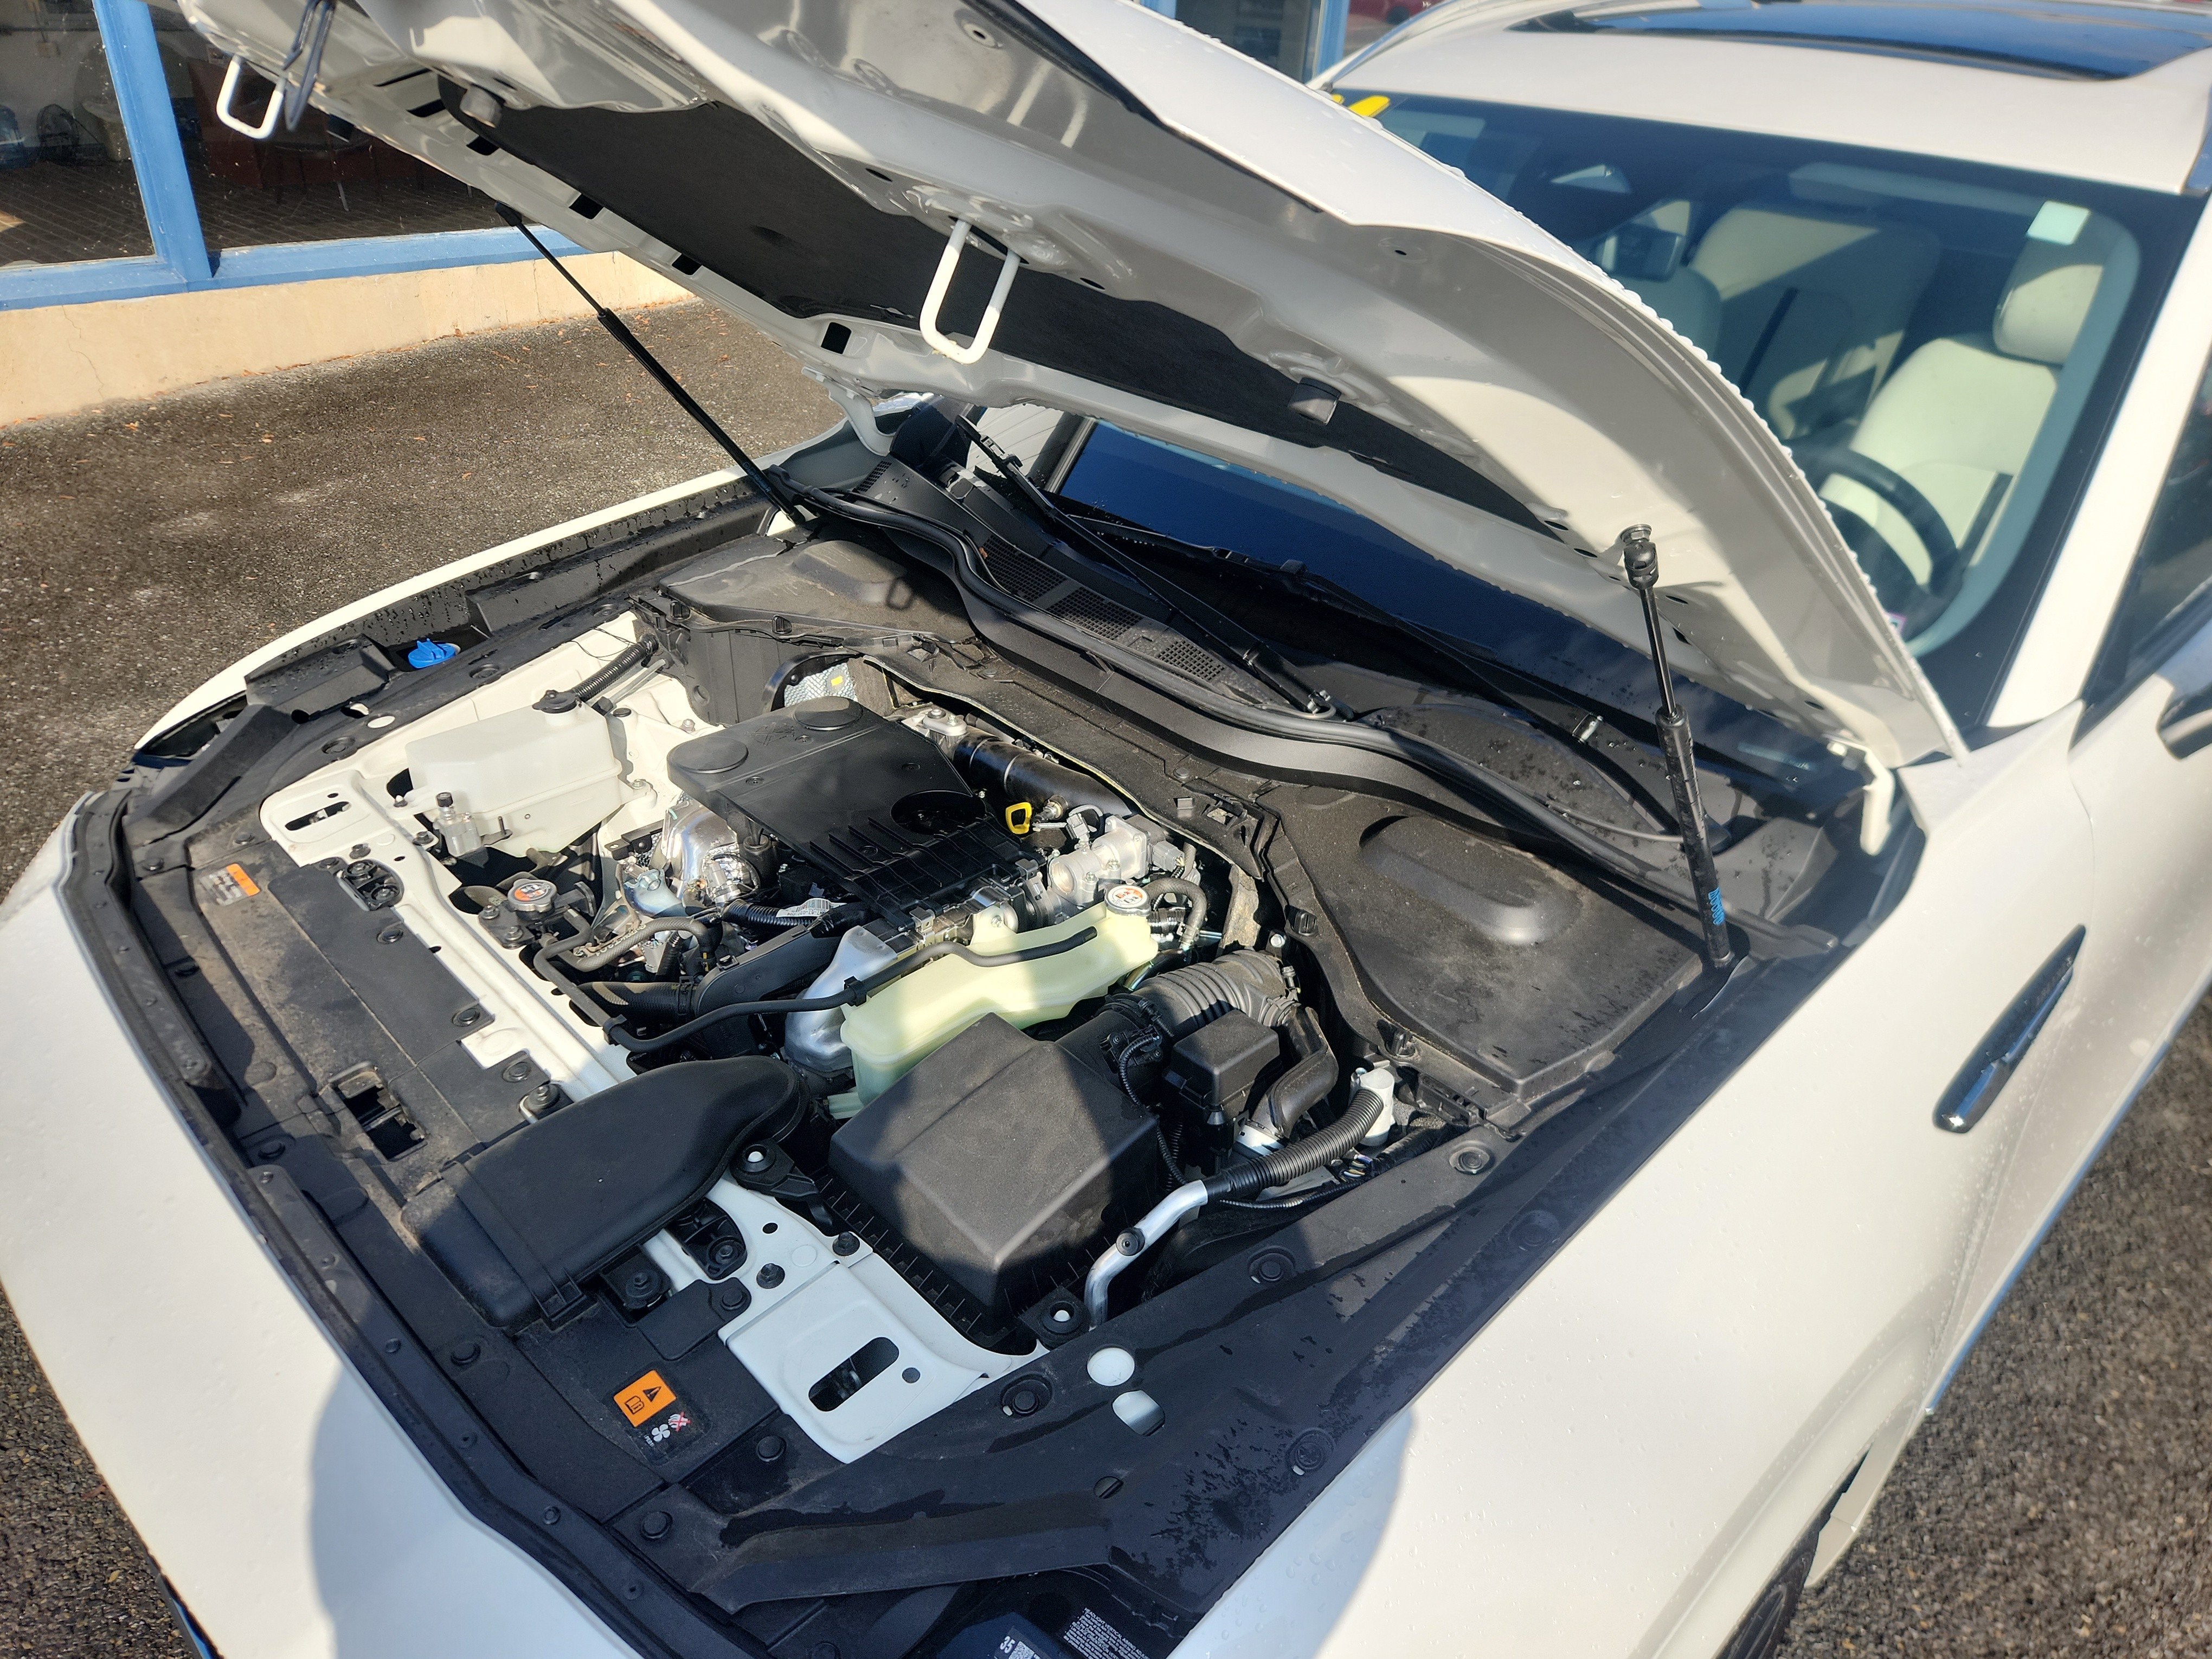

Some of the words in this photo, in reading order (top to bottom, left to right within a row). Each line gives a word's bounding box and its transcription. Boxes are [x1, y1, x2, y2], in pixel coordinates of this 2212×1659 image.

[1084, 1607, 1105, 1625] HEADLIGHT
[1104, 1623, 1122, 1639] VERTICAL
[1000, 1636, 1015, 1653] 35
